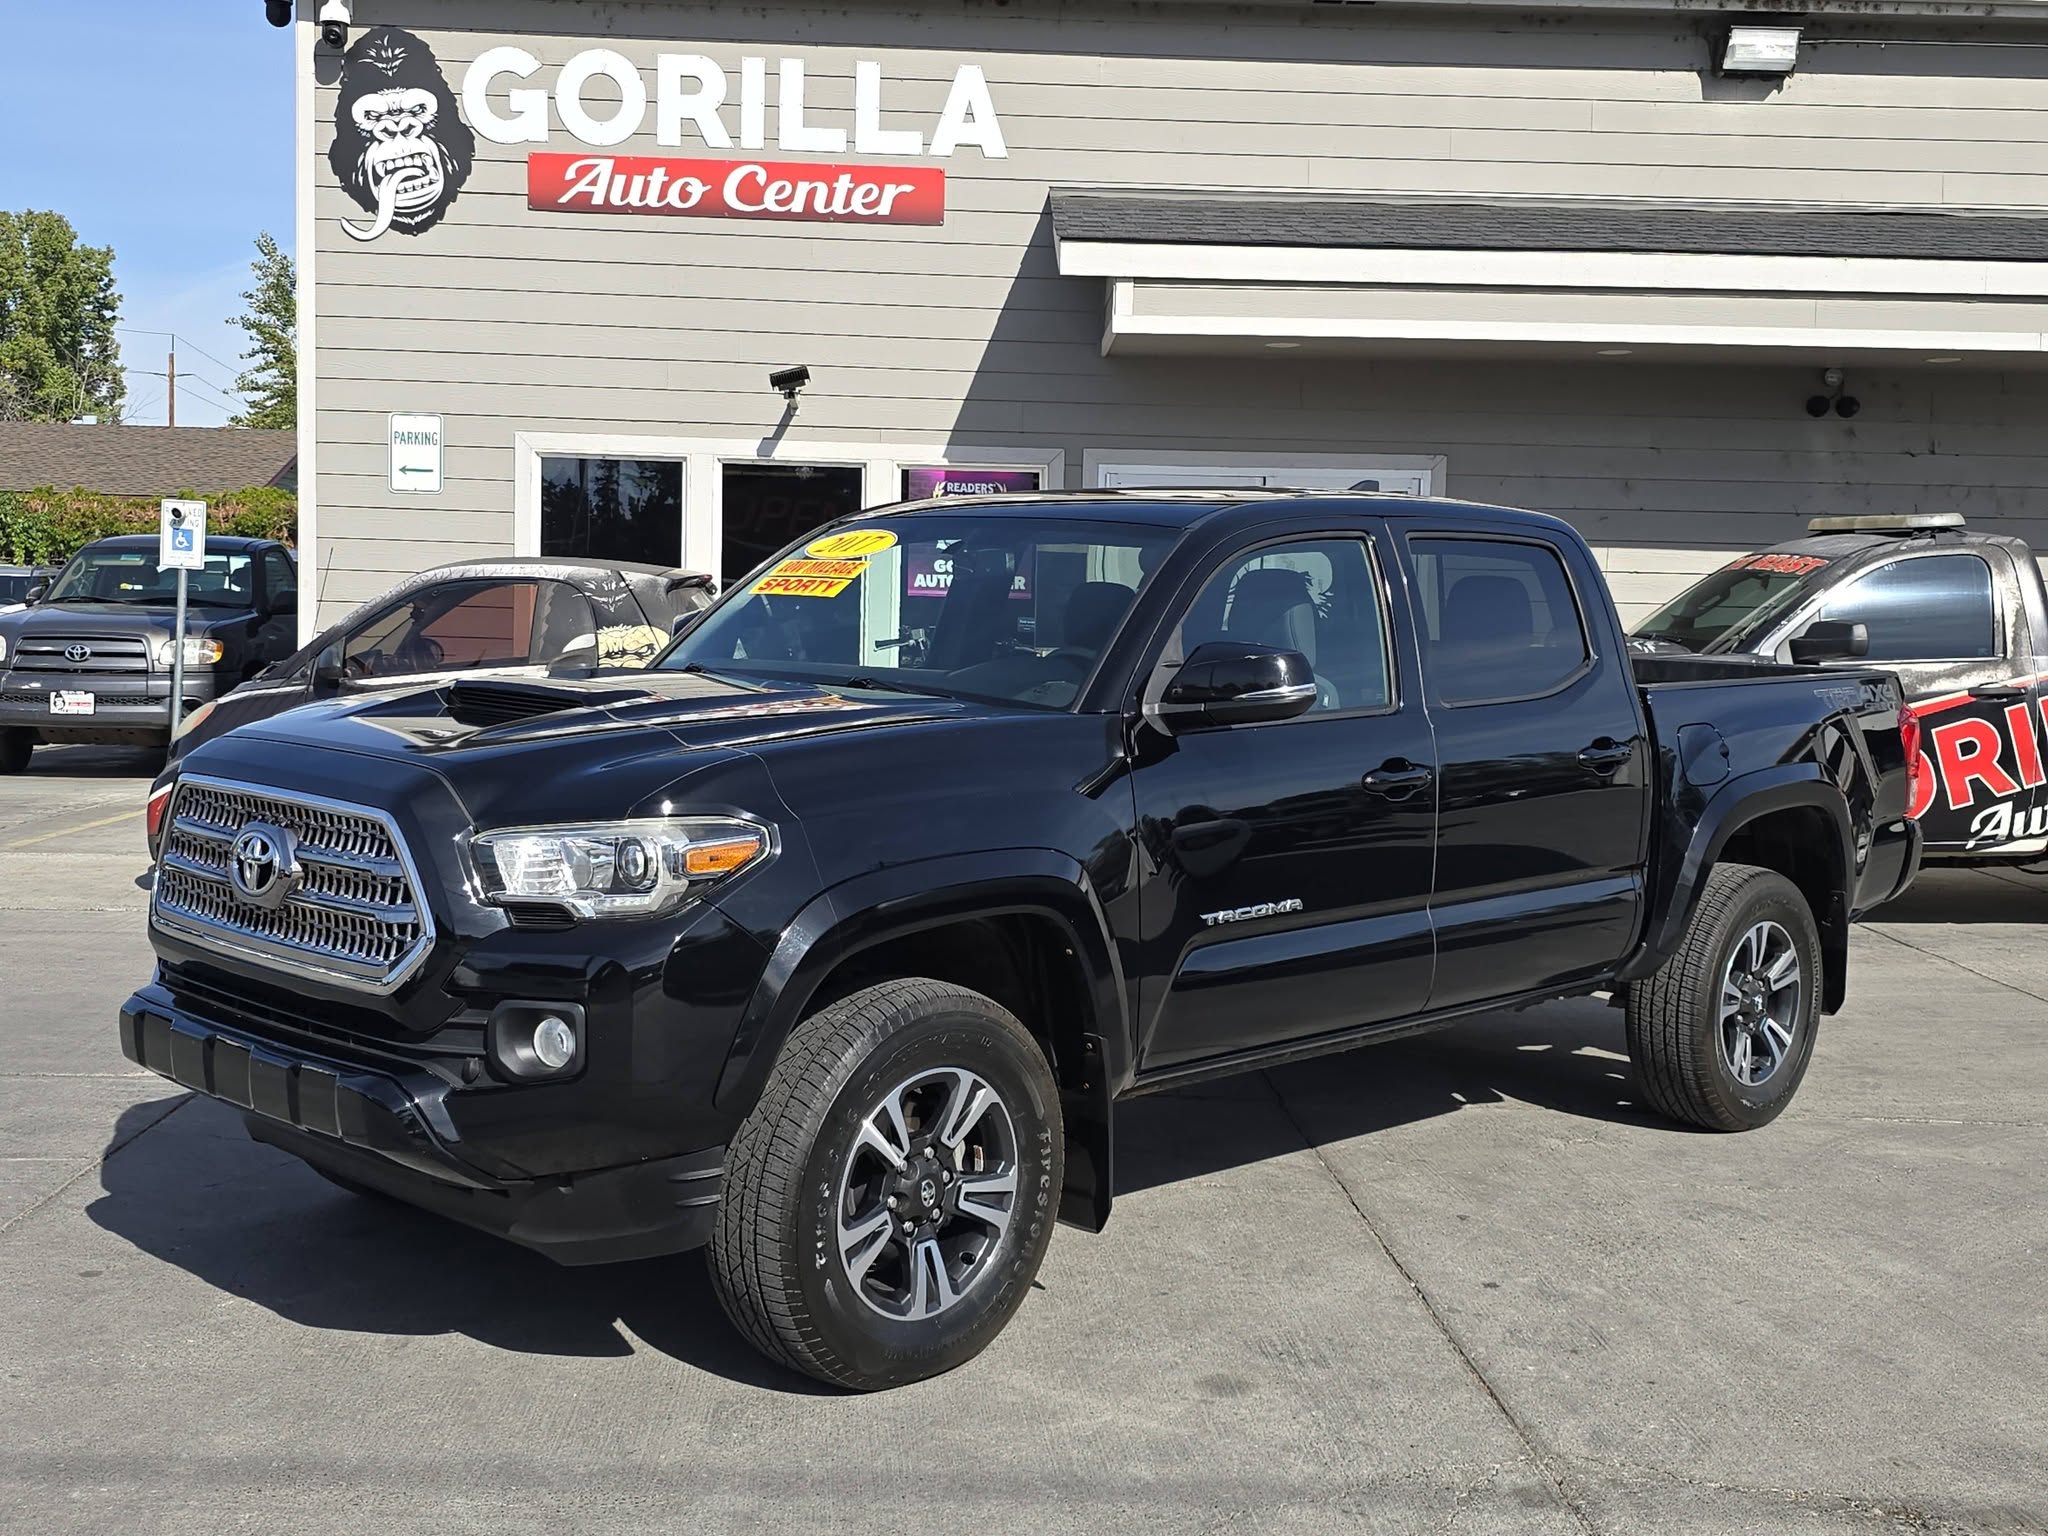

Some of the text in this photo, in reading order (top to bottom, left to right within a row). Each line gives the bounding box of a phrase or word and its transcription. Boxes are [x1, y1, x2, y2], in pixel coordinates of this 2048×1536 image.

[462, 46, 1009, 159] GORILLA
[557, 157, 915, 217] Auto Center
[394, 430, 438, 446] PARKING
[813, 535, 889, 553] 2017
[757, 578, 843, 593] SPORTY
[1200, 898, 1303, 925] TACOMA
